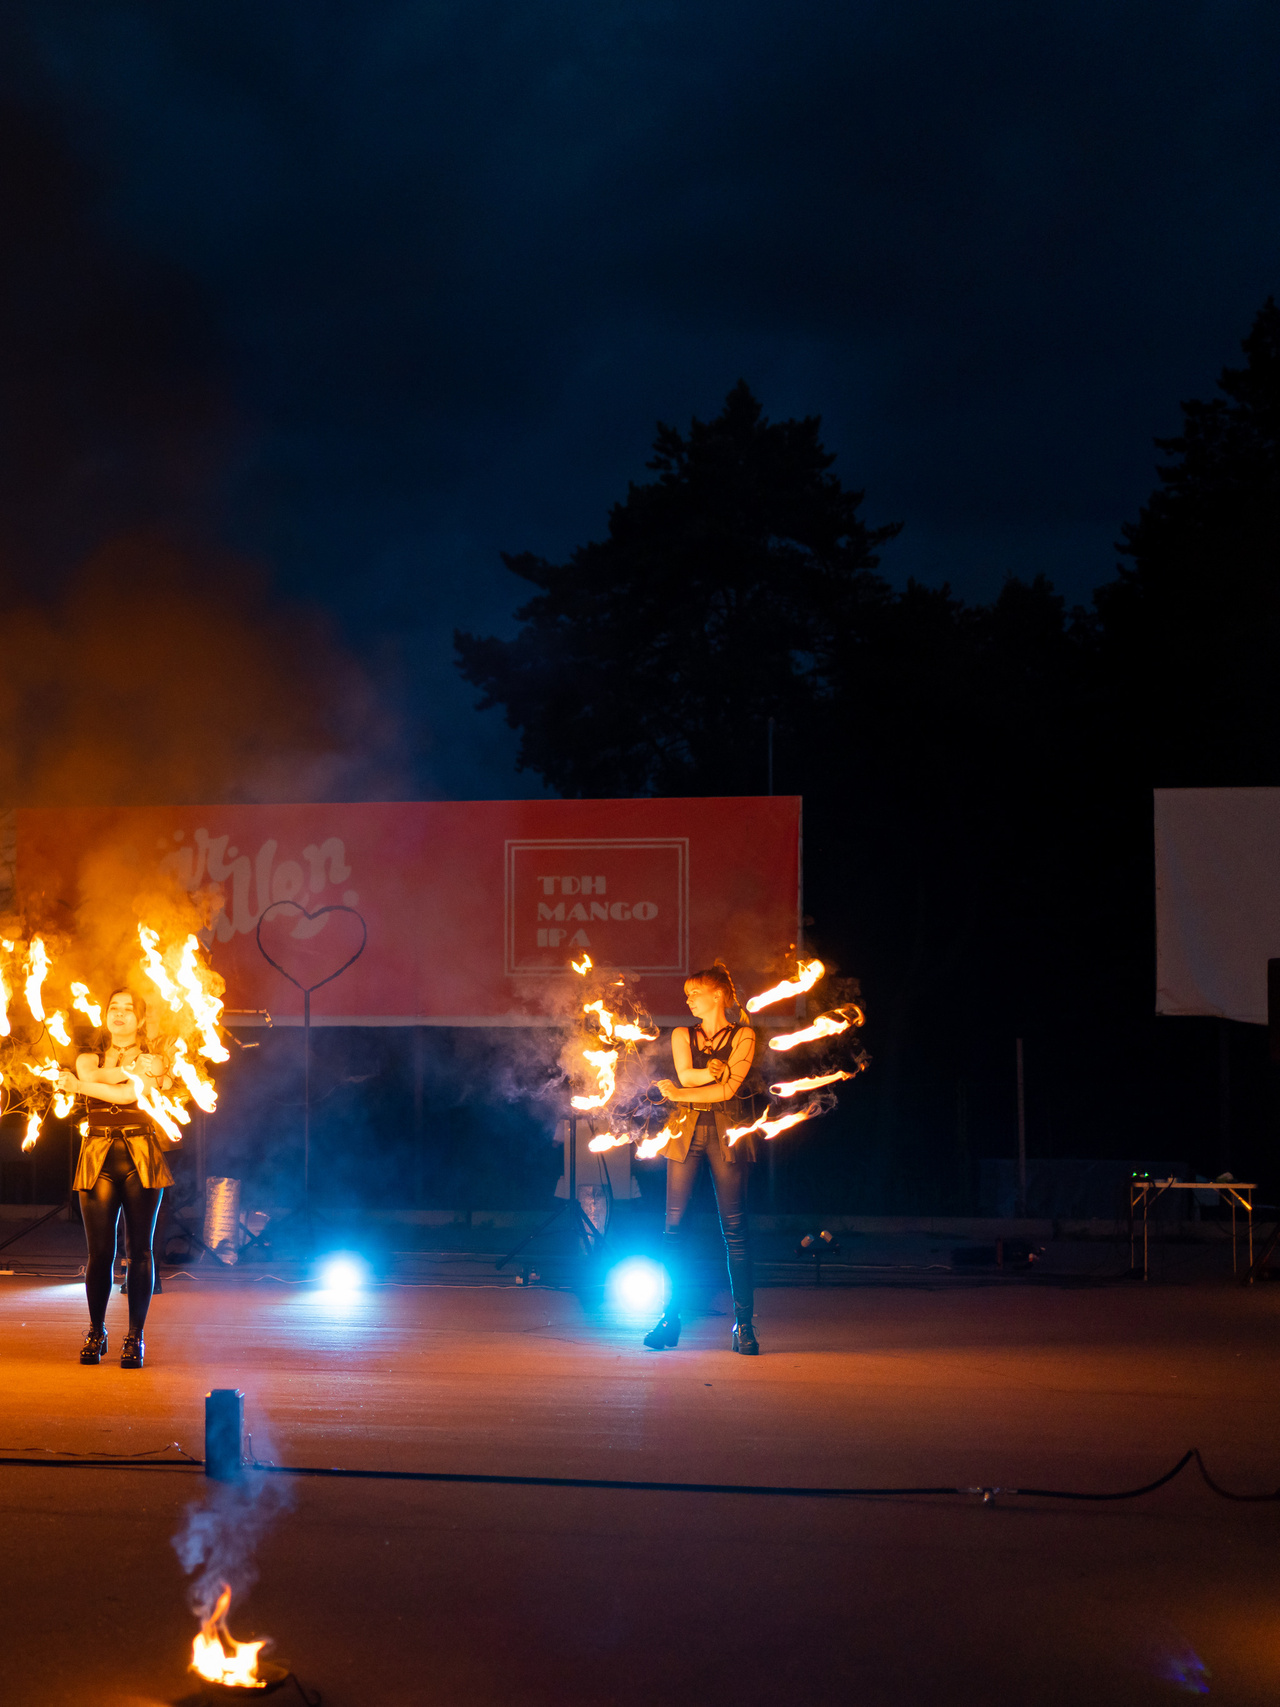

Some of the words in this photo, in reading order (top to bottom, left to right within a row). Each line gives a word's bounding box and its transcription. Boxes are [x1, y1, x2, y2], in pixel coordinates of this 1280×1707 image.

[536, 875, 607, 895] TDH
[536, 901, 659, 922] MANGO
[536, 928, 591, 948] IPA
